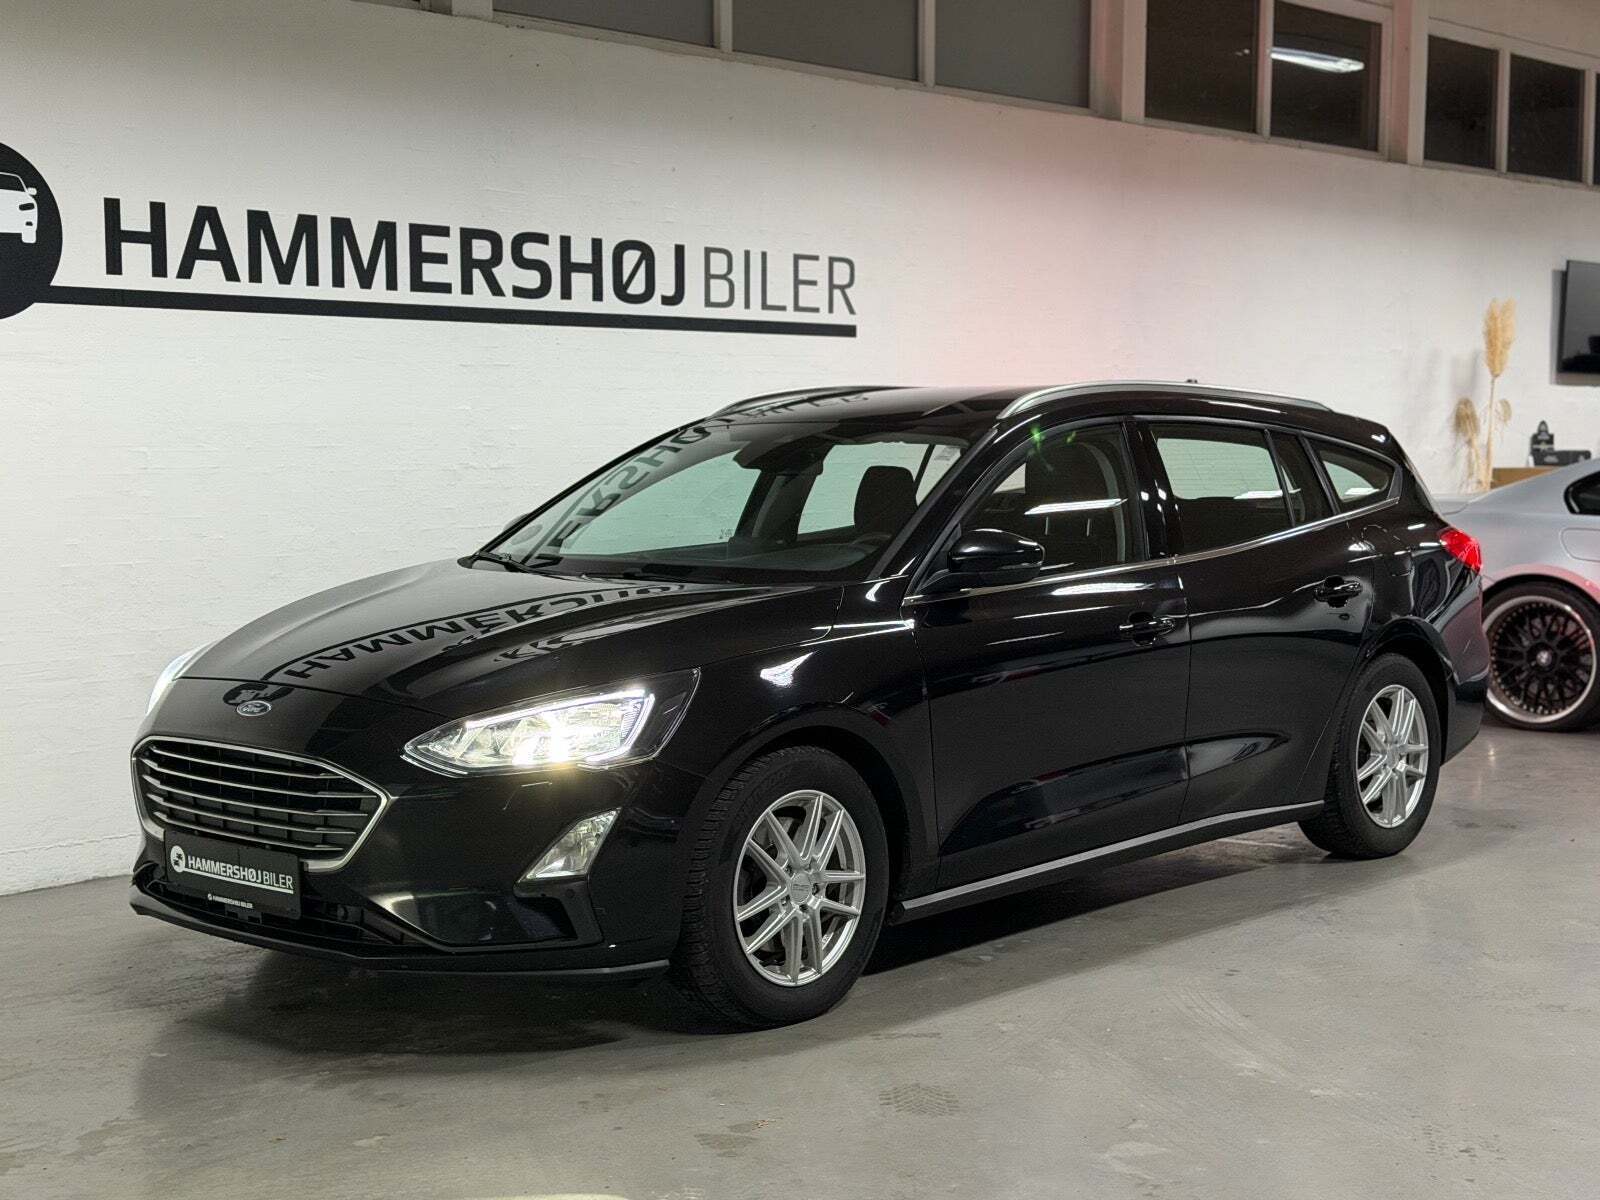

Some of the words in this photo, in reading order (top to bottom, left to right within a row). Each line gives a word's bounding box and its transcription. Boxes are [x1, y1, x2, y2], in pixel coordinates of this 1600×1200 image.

[103, 197, 685, 306] HAMMERSHØJ
[703, 247, 857, 316] BILER
[187, 855, 262, 883] HAMMERSHØJ
[262, 871, 294, 889] BILER
